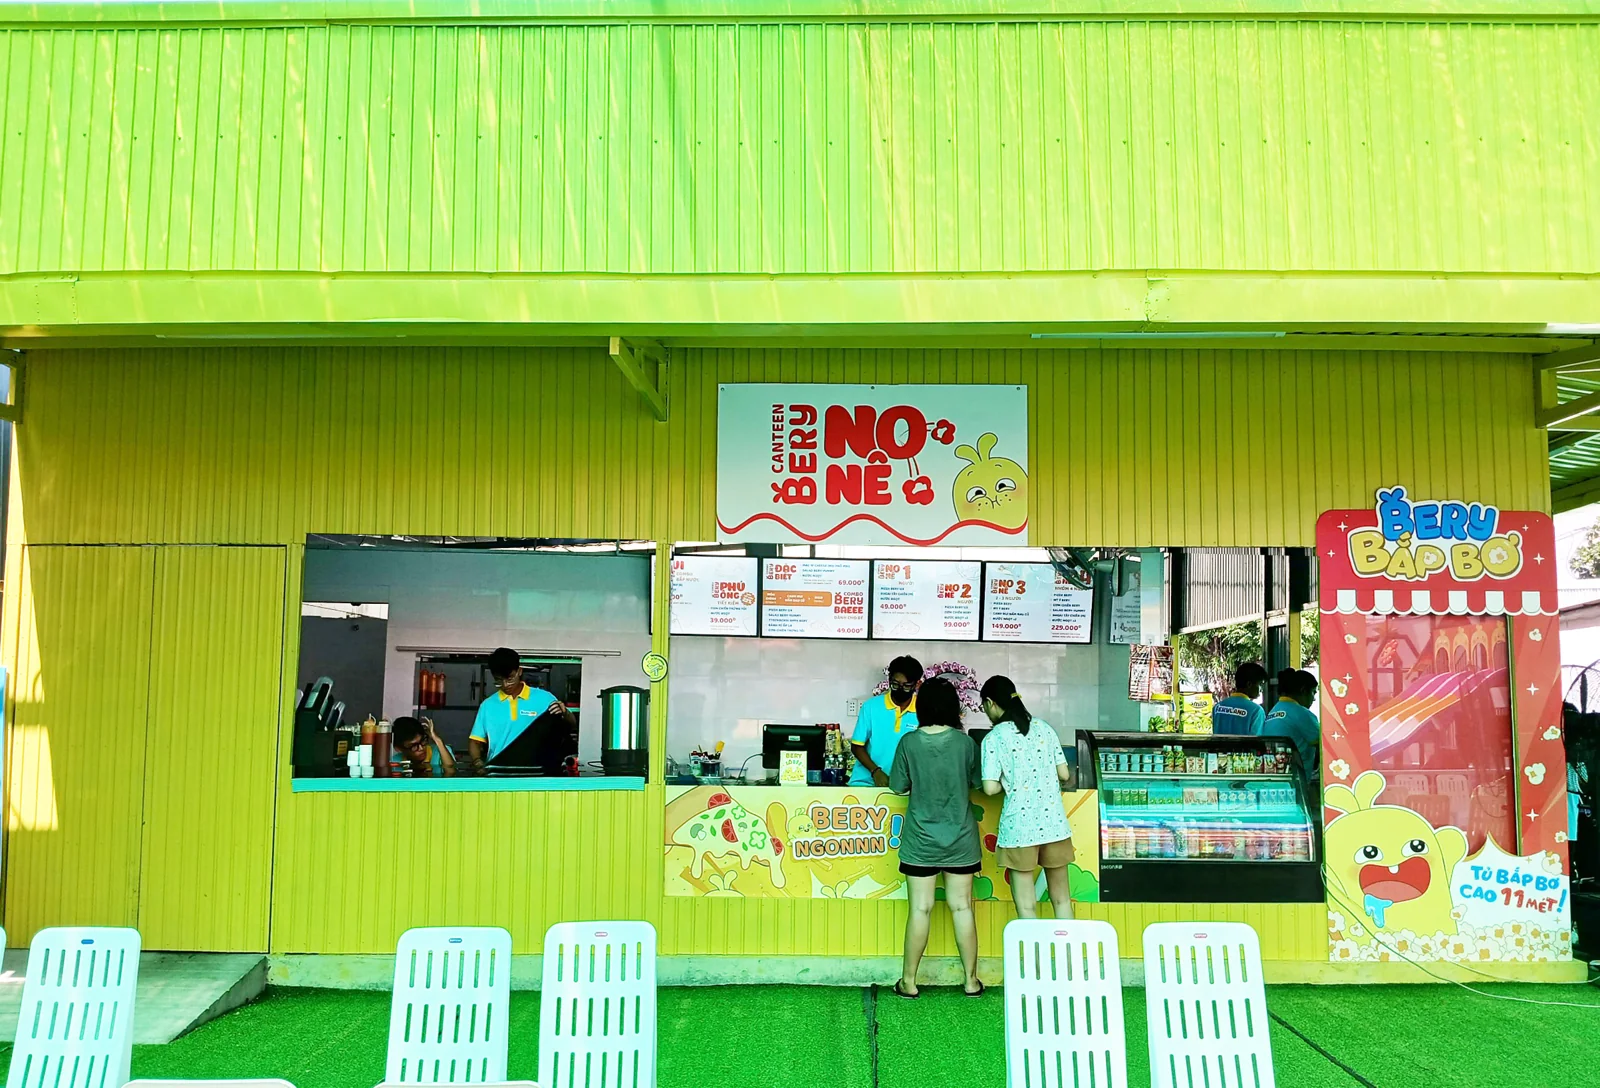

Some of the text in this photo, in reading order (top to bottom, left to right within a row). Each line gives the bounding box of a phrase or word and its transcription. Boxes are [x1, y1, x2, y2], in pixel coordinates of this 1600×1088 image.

[772, 404, 784, 473] CANTEEN
[824, 405, 928, 460] NO
[773, 404, 818, 504] BERY
[826, 450, 892, 505] NÊ
[1379, 488, 1497, 542] BERY
[1451, 533, 1520, 578] BƠ
[886, 565, 911, 579] NO 1
[834, 592, 863, 605] BERY
[945, 584, 971, 598] NO 2
[1016, 580, 1026, 594] 3
[834, 606, 863, 614] BAEEE
[811, 807, 887, 830] BERY
[795, 837, 886, 857] NGONNN
[1536, 876, 1560, 891] BƠ
[1460, 885, 1497, 902] CAO
[1501, 888, 1524, 908] 11
